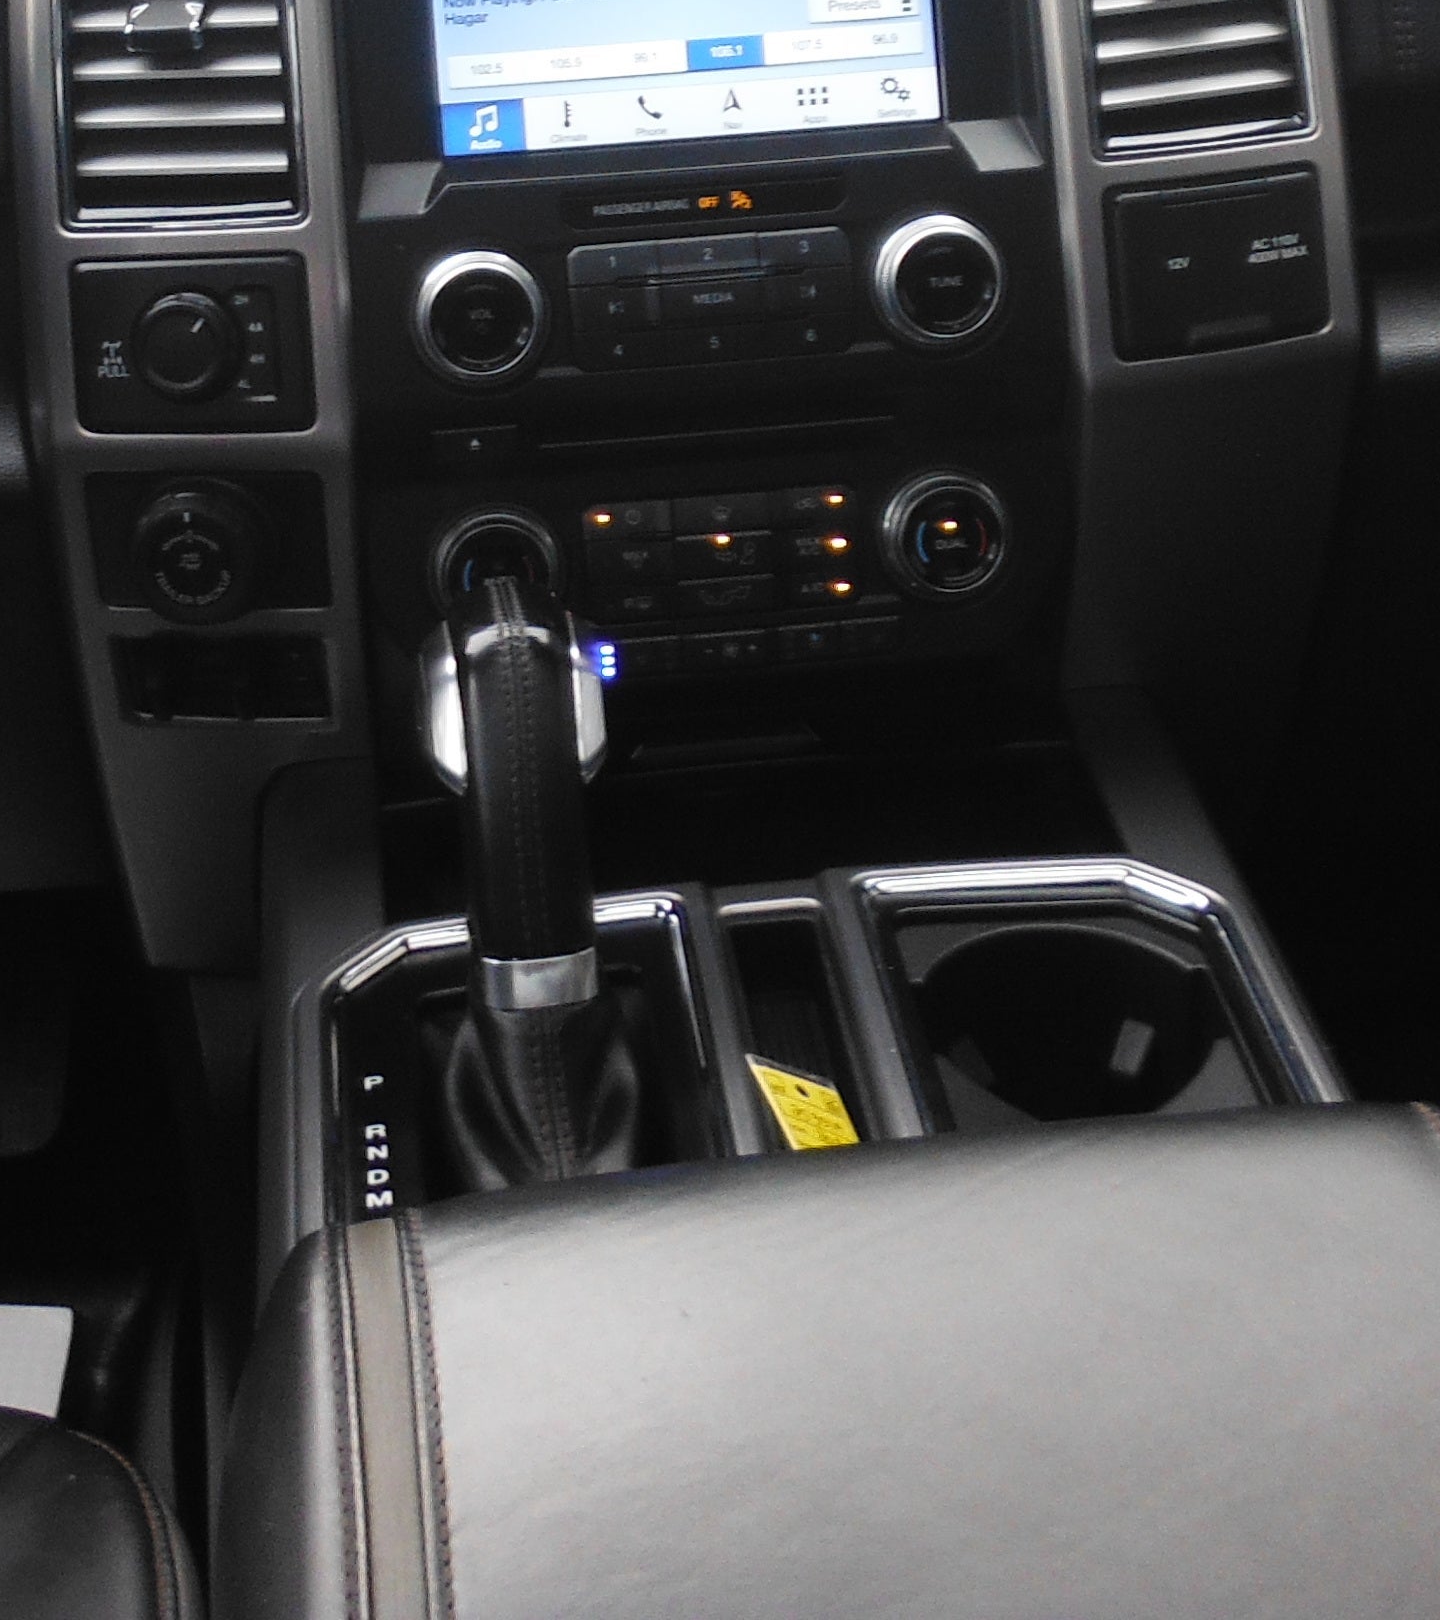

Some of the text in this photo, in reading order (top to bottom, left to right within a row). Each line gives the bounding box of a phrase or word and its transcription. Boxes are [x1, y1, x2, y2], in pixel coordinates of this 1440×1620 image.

[443, 12, 489, 28] Hagar
[877, 107, 918, 119] Settings
[635, 127, 668, 138] Phone
[696, 195, 720, 210] OFF
[702, 246, 714, 261] 2
[798, 239, 810, 254] 3
[608, 255, 618, 269] 1
[928, 275, 965, 289] TUNE
[692, 291, 735, 305] MEDIA
[708, 335, 720, 349] 5
[364, 1075, 384, 1091] P
[365, 1124, 387, 1140] R
[366, 1145, 389, 1161] N
[366, 1169, 390, 1186] D
[366, 1191, 393, 1208] M
